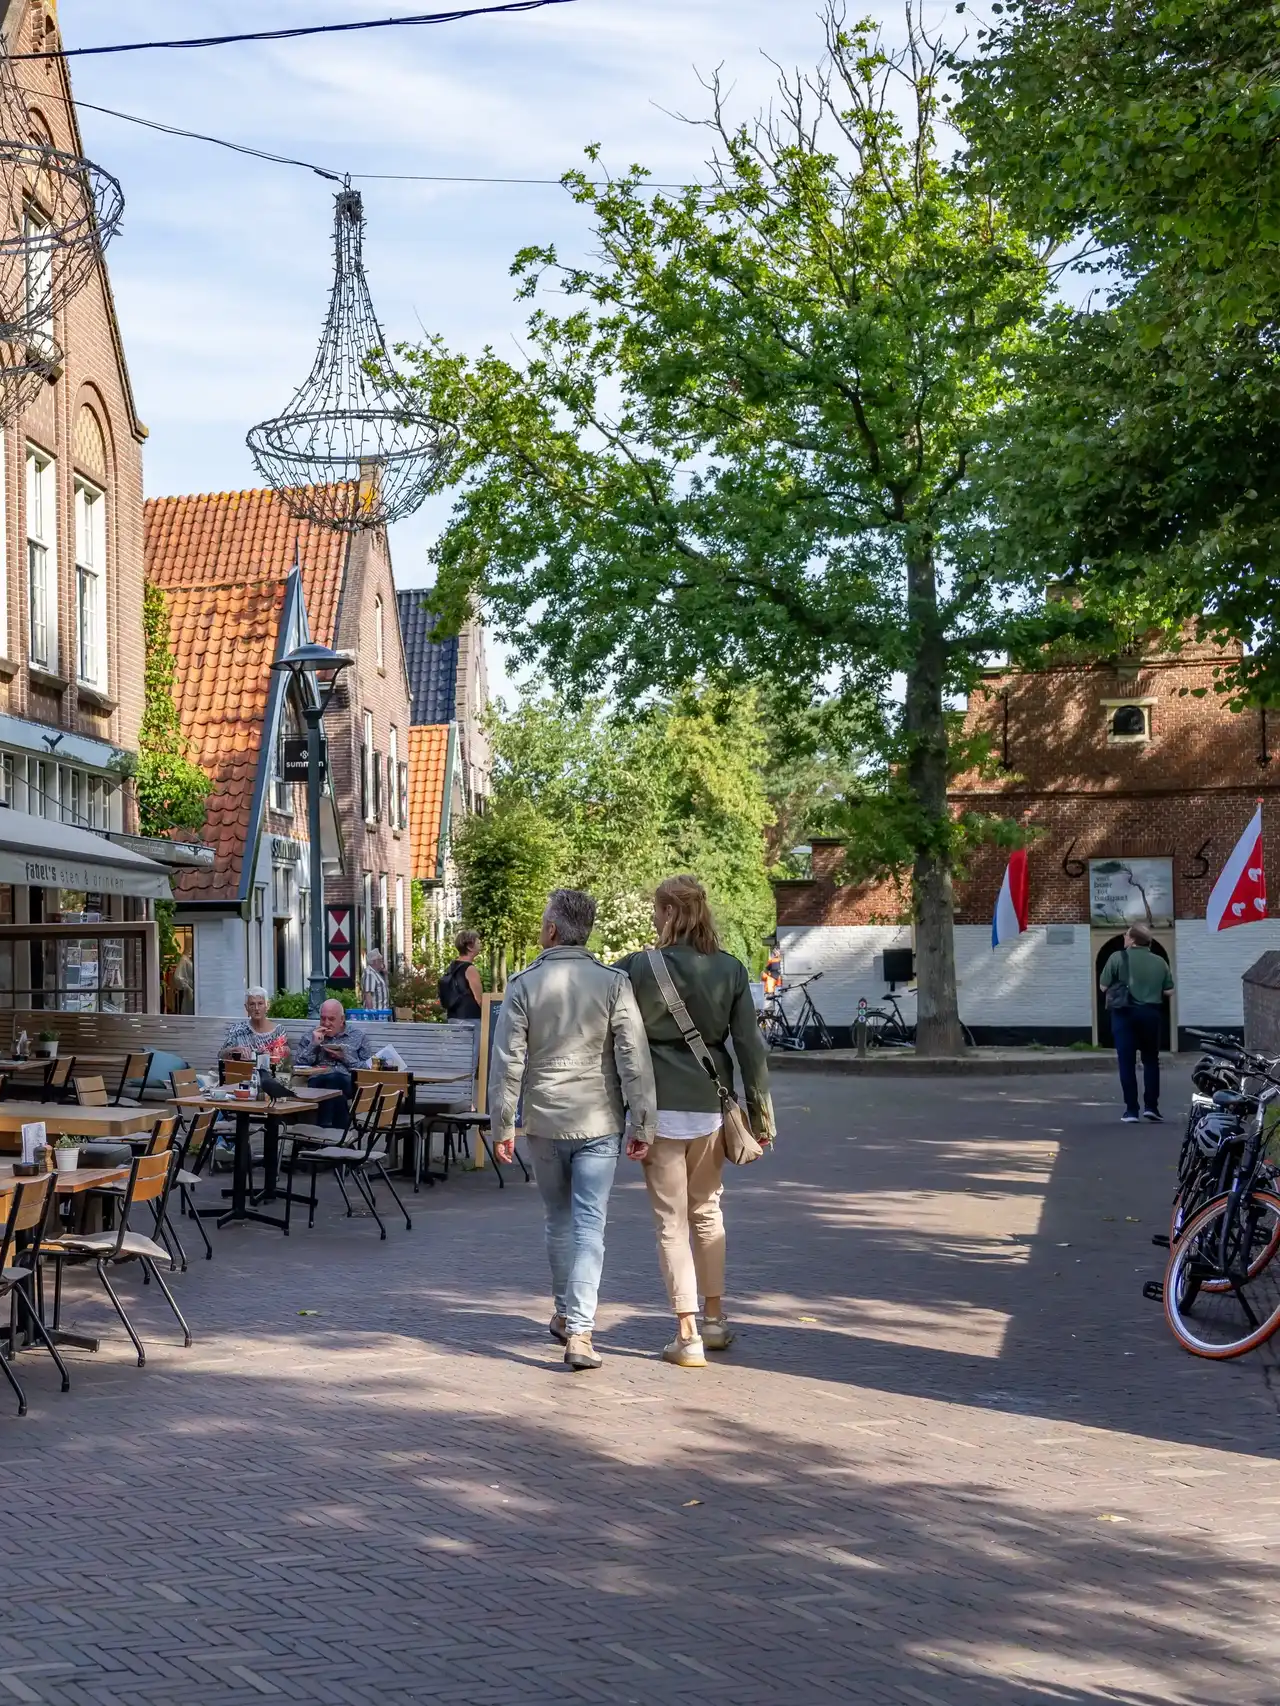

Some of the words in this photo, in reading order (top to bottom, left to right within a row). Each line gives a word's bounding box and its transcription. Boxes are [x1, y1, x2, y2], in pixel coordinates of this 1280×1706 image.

[26, 862, 56, 882] fabel's
[60, 871, 80, 884] eten
[93, 873, 124, 889] drinken
[1062, 837, 1086, 879] 6
[1182, 837, 1212, 880] 5
